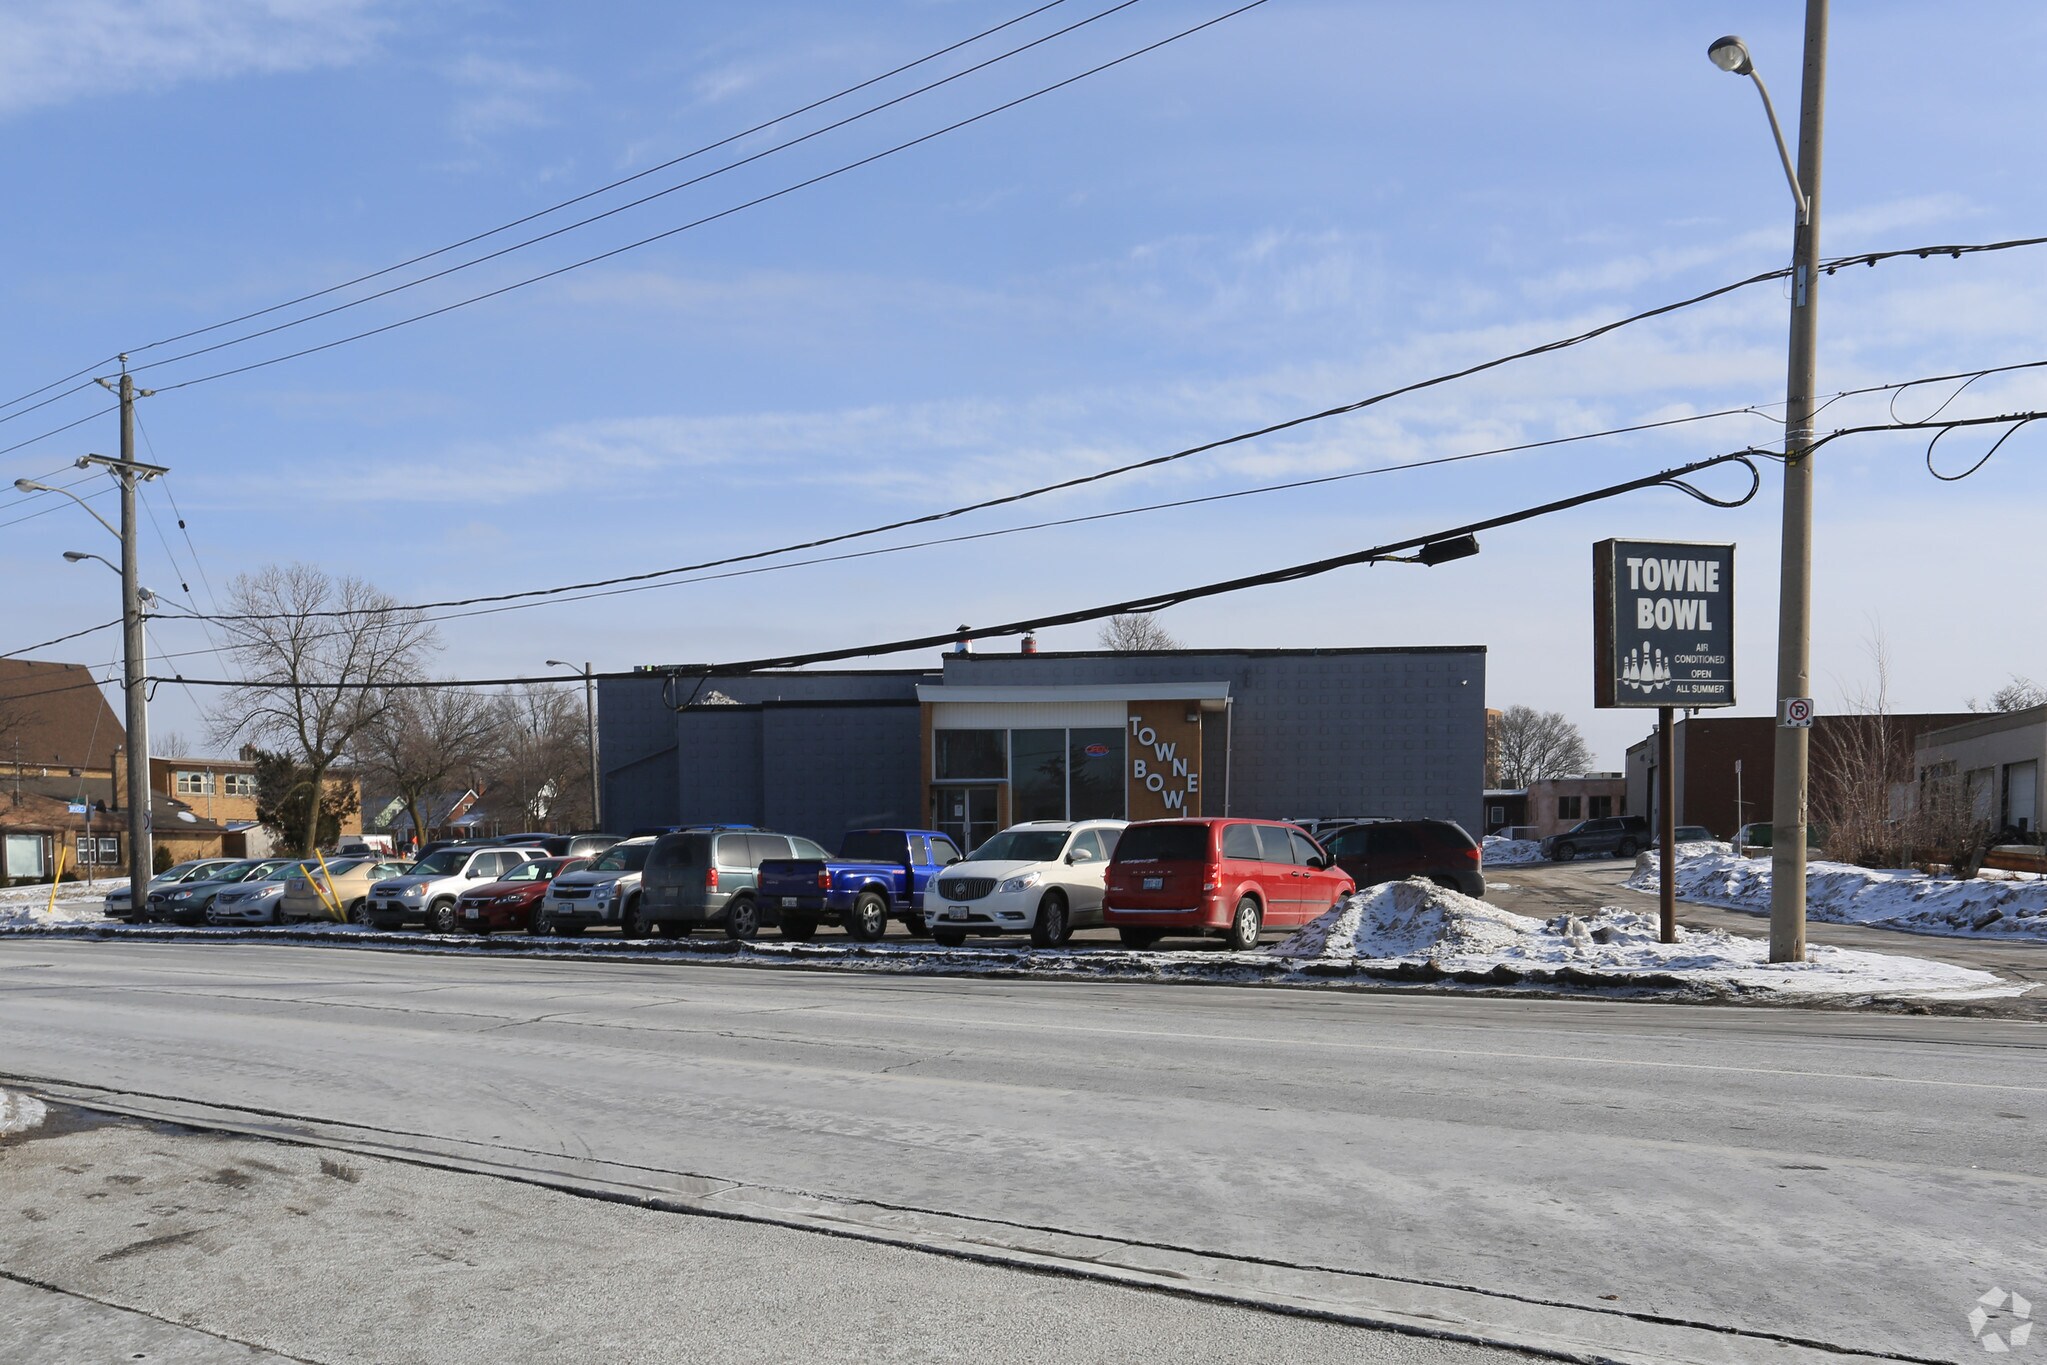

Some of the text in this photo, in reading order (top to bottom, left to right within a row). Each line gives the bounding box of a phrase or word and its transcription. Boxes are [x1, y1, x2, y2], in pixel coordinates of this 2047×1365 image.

[1627, 557, 1719, 592] TOWNE
[1637, 597, 1712, 631] BOWL
[1696, 643, 1709, 652] AIR
[1674, 654, 1725, 664] CONDITIONED
[1691, 669, 1712, 678] OPEN
[1676, 684, 1725, 693] ALL SUMMER
[1129, 716, 1198, 793] TOWNE
